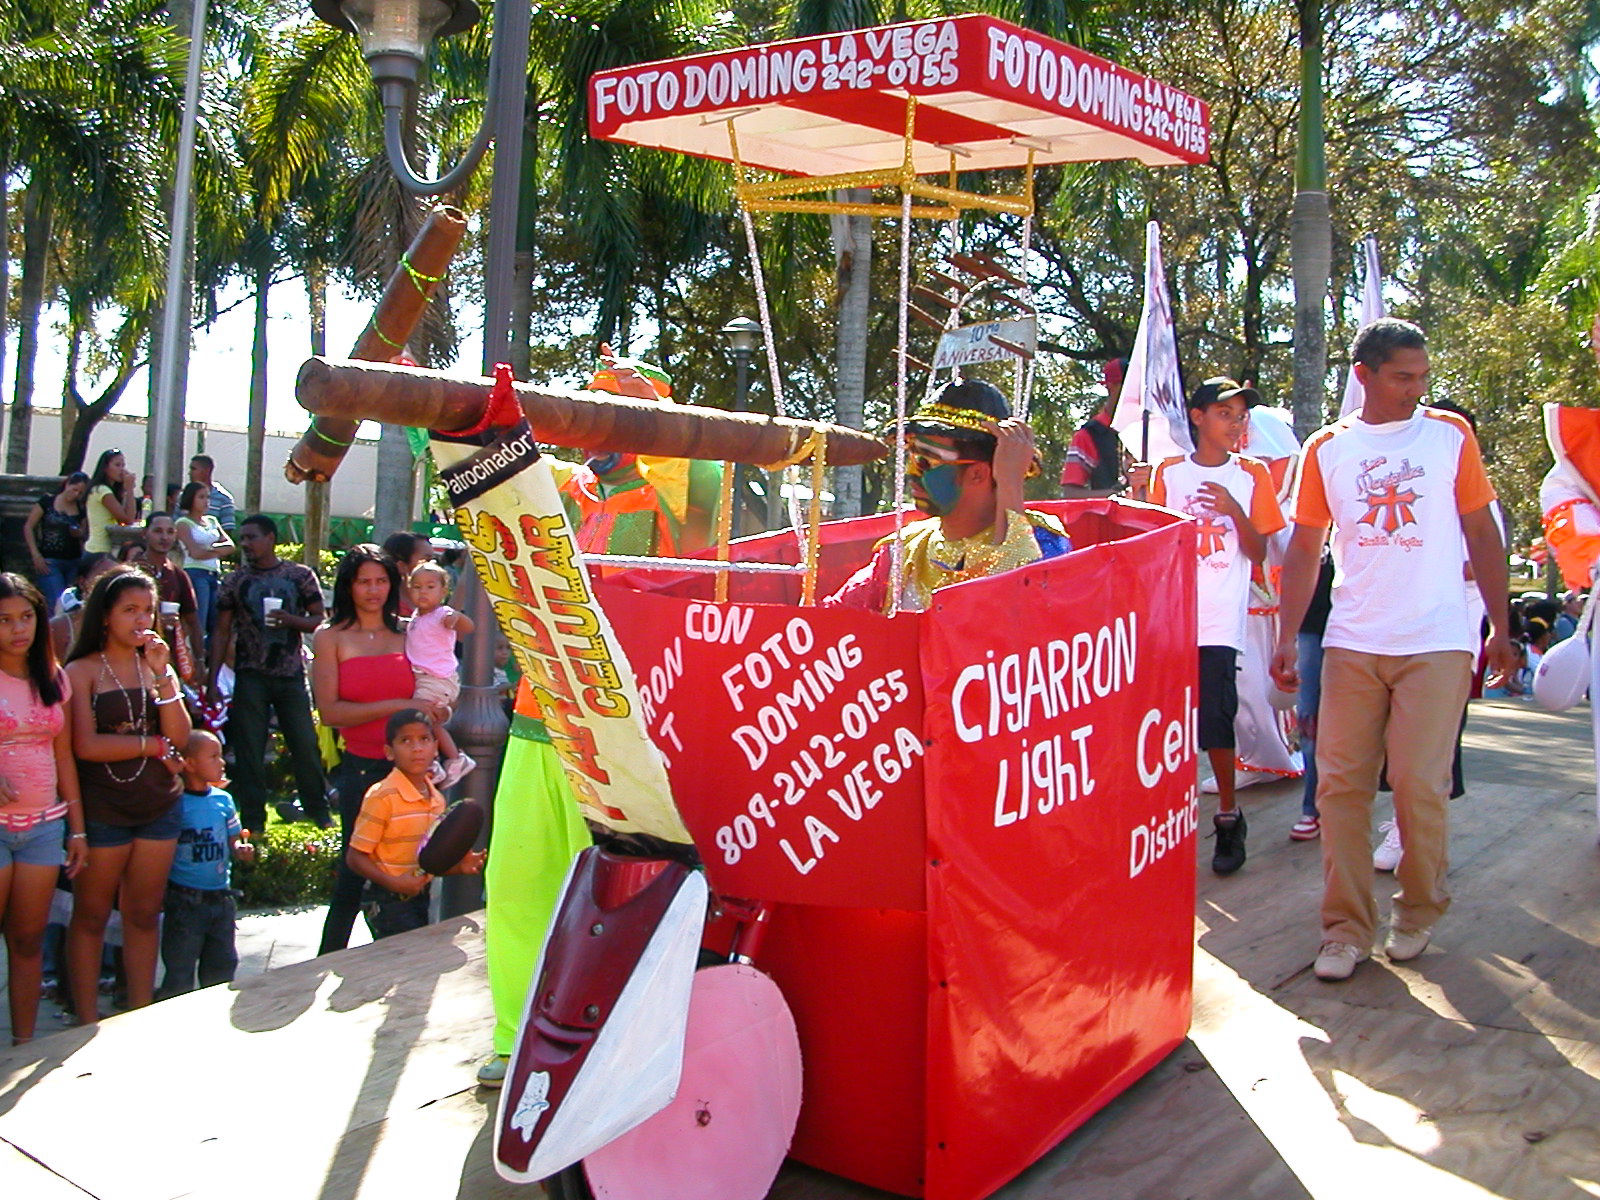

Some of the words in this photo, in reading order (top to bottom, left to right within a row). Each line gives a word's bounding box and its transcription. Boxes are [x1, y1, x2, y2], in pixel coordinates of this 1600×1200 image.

[821, 39, 857, 64] LA
[863, 20, 960, 61] VEGA
[821, 50, 960, 90] 242-0155
[987, 27, 1058, 100] FOTO
[594, 70, 680, 124] FOTO
[1144, 79, 1162, 105] LA
[1166, 86, 1202, 124] VEGA
[1144, 106, 1206, 155] 242-0155
[519, 512, 631, 720] CELULAR
[685, 604, 754, 645] CON
[455, 507, 629, 822] PAREDES
[721, 617, 815, 712] FOTO
[715, 668, 909, 865] 809-242-0155
[779, 815, 841, 875] LA
[827, 727, 925, 821] VEGA
